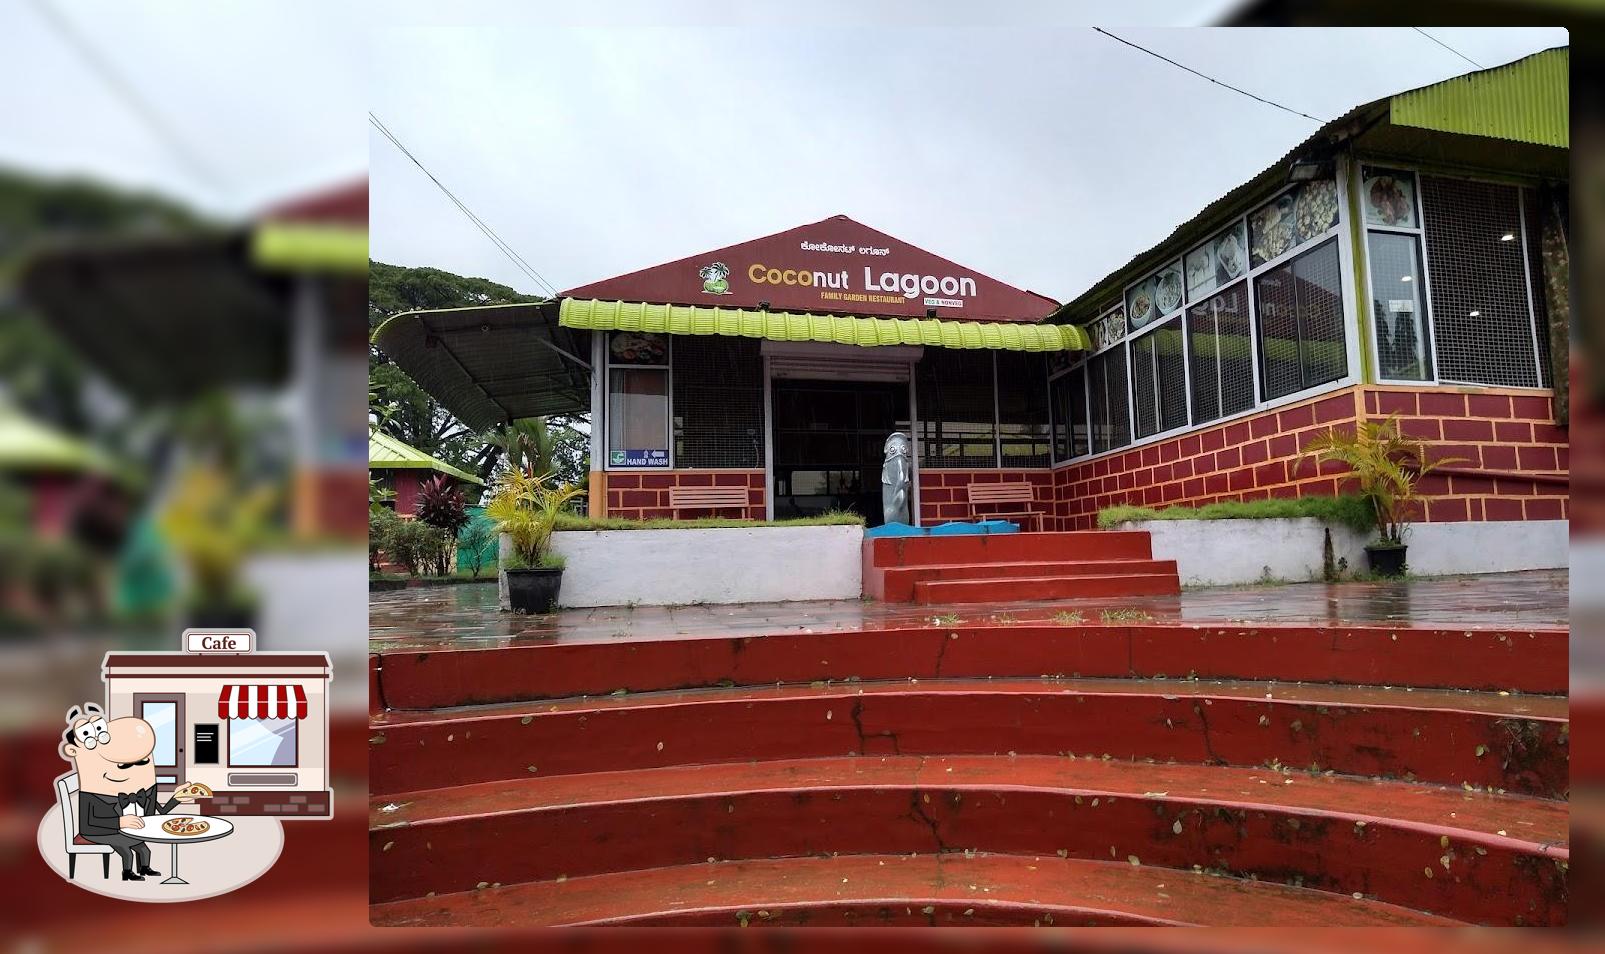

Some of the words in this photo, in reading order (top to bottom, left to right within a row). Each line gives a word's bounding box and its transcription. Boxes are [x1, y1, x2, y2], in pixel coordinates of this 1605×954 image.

[748, 263, 849, 290] Coconut
[864, 266, 977, 299] Lagoon
[820, 291, 843, 300] FAMILY
[843, 293, 867, 302] GARDEN
[868, 295, 905, 304] RESTAURANT
[626, 458, 647, 466] HAND
[647, 458, 668, 466] WASH
